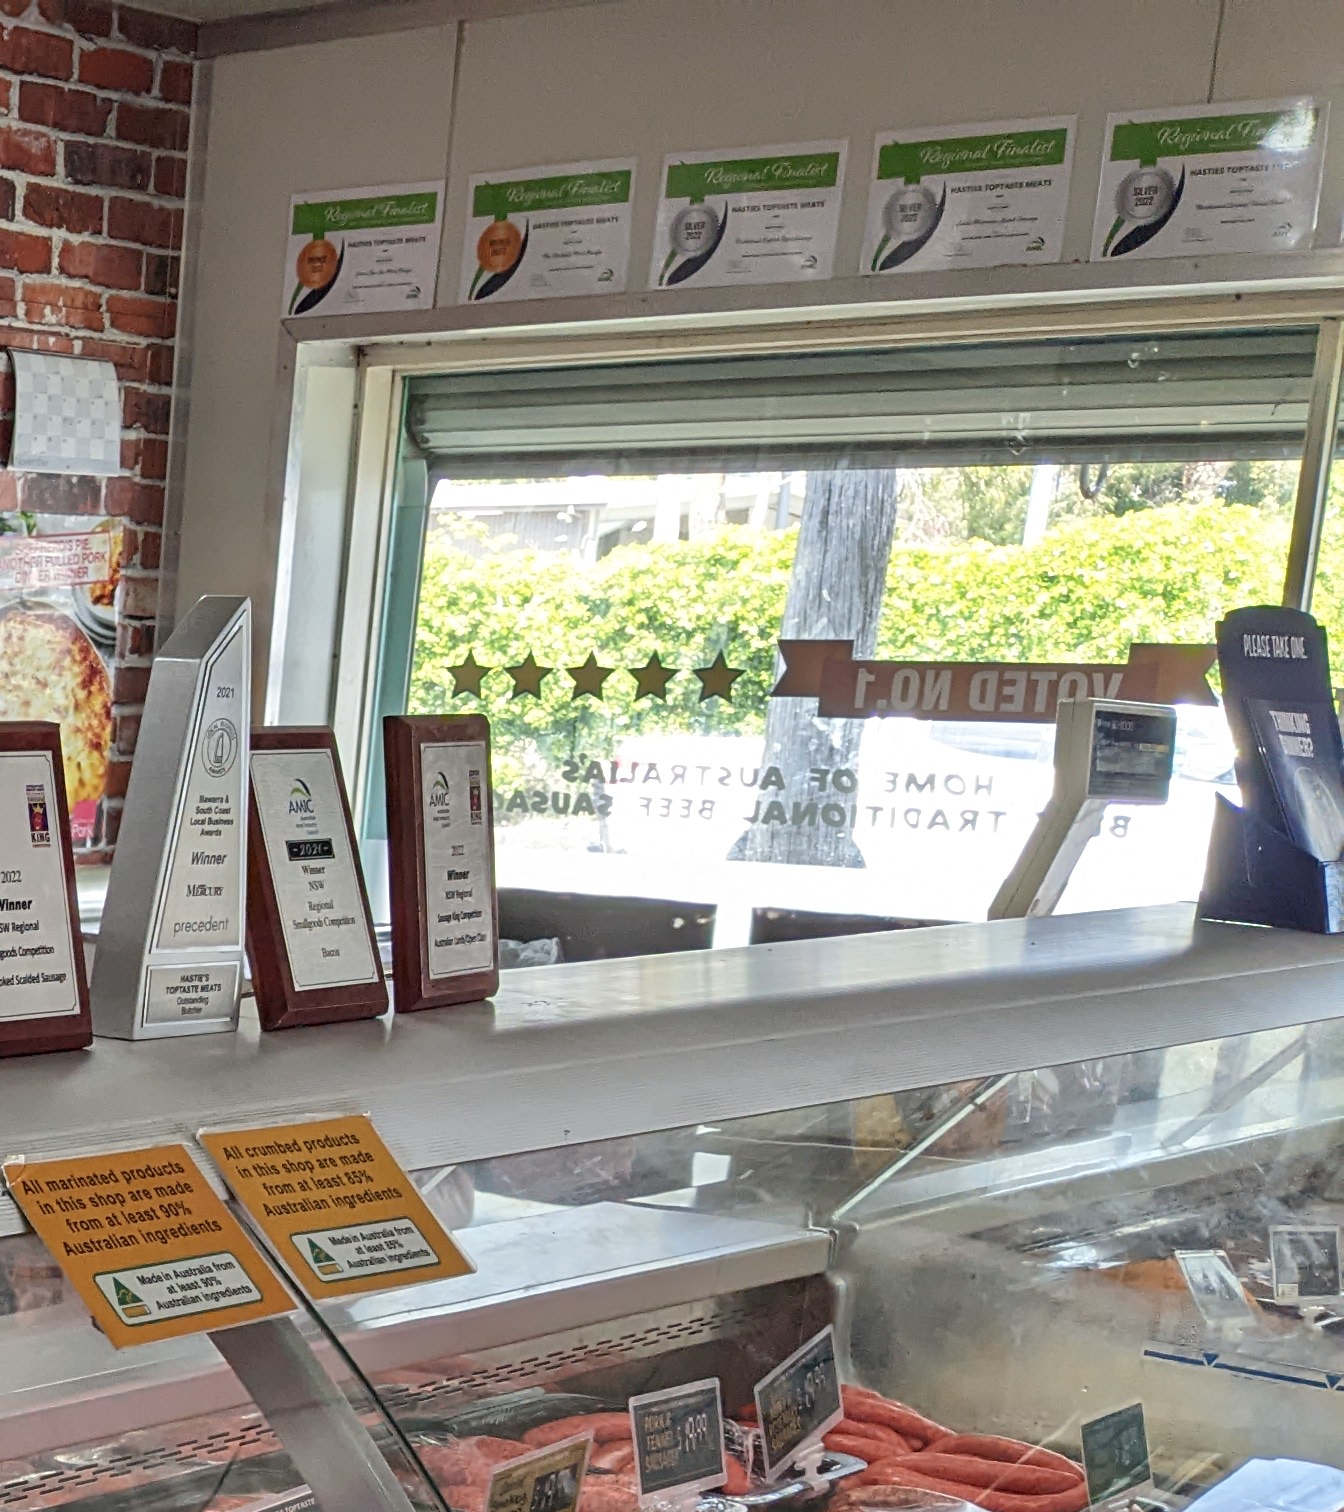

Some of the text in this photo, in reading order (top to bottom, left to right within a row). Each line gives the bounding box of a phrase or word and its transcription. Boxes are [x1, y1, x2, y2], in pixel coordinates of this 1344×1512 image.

[1157, 124, 1236, 150] Regional
[920, 139, 1055, 167] Regional Finalist
[705, 161, 828, 186] Regional Finalist
[82, 551, 107, 563] PORK
[1243, 634, 1291, 658] PLEASE TAKE
[216, 686, 235, 698] 2021
[288, 799, 314, 814] AMIC
[30, 832, 51, 843] KING
[190, 851, 228, 866] Winner
[0, 871, 22, 884] 2022
[11, 920, 40, 933] Regional
[173, 917, 229, 937] precedent
[18, 945, 55, 957] Competition
[15, 974, 40, 985] Scalded
[180, 973, 210, 983] HASTIE'S
[222, 1132, 360, 1161] All crumbed products
[236, 1149, 375, 1179] in this shop are made
[21, 1160, 185, 1196] All marinated products
[263, 1169, 374, 1197] from at least 85%
[36, 1181, 194, 1215] in this shop are made
[262, 1186, 403, 1218] Australian ingredients
[66, 1201, 192, 1233] from at least 90%
[62, 1219, 222, 1257] Australian ingredients
[137, 1260, 236, 1286] Made Australia from
[166, 1276, 221, 1294] at least 90%
[156, 1284, 253, 1311] Australian ingredients
